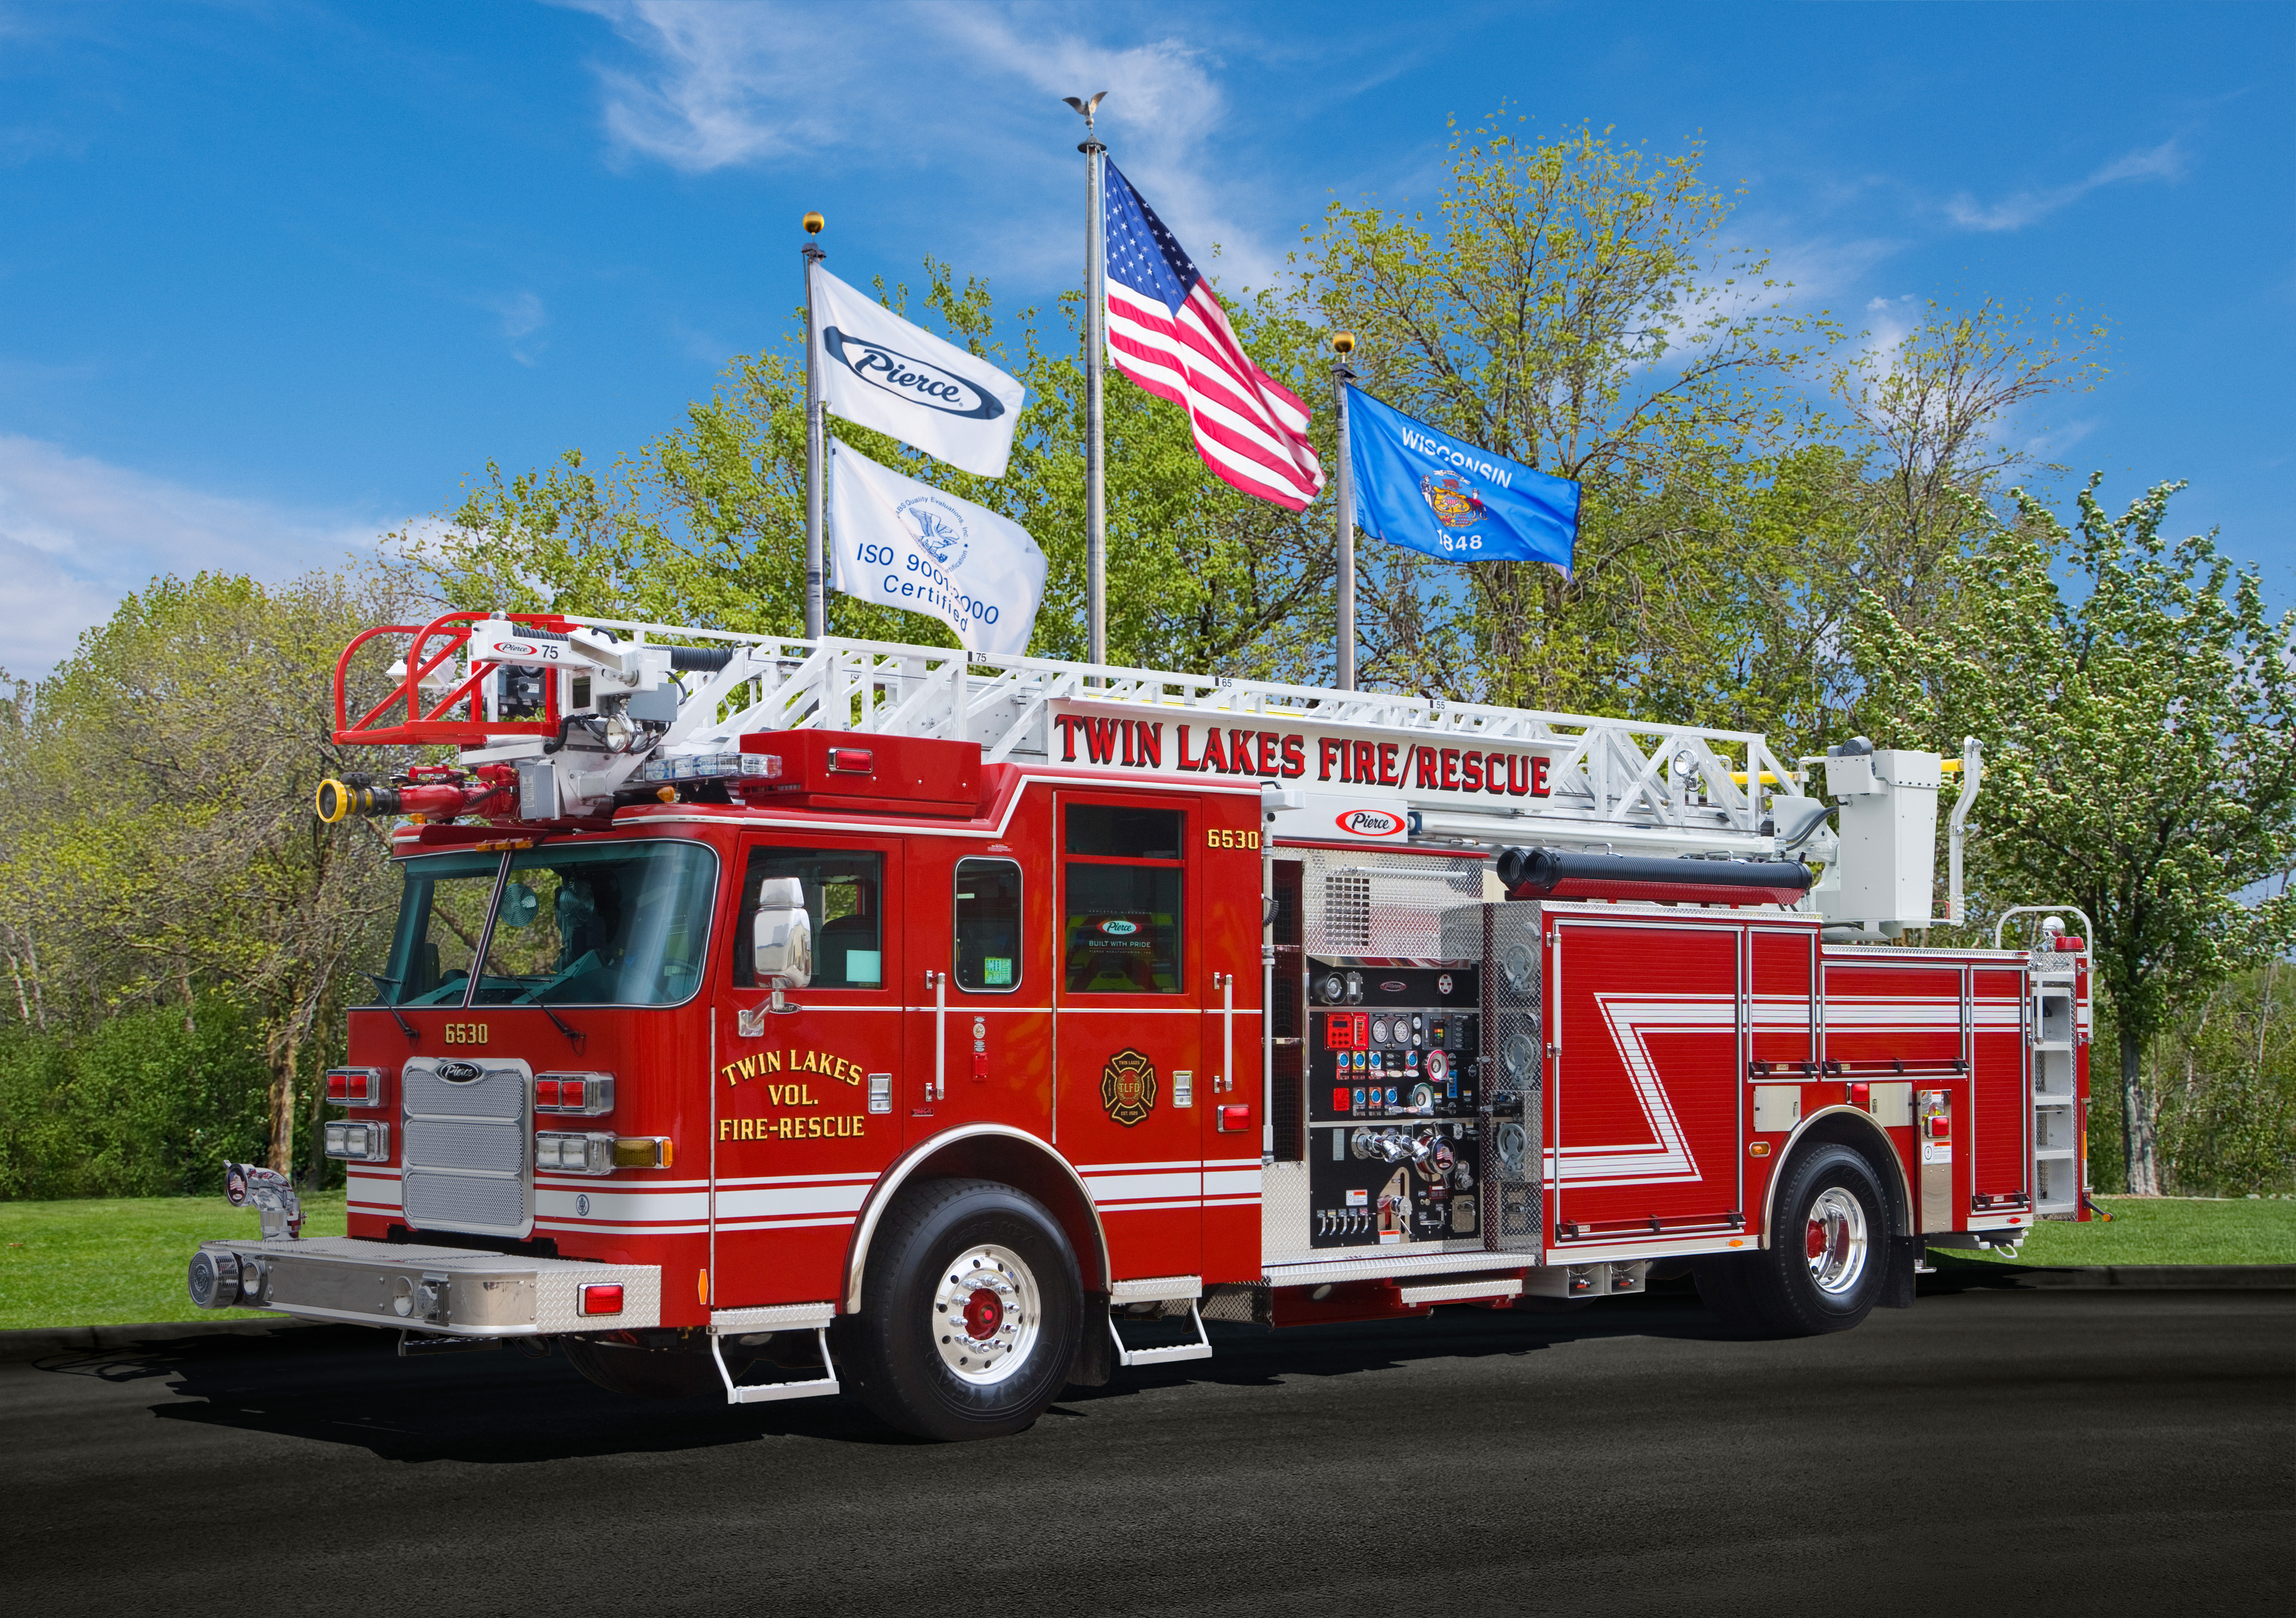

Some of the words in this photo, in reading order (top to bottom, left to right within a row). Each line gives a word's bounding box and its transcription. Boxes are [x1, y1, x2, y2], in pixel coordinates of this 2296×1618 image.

[855, 349, 961, 403] Pierce
[1402, 427, 1513, 489] WISCONSIN
[895, 502, 906, 516] ABS
[905, 496, 928, 506] Quality
[930, 496, 964, 526] Evaluations,
[1437, 529, 1482, 551] 1848
[856, 543, 894, 566] ISO
[906, 553, 999, 625] 9001:2000
[883, 574, 968, 633] Certified
[502, 644, 527, 652] Pierce
[542, 645, 559, 659] 75
[976, 653, 987, 662] 75
[1222, 678, 1232, 688] 65
[1436, 701, 1445, 709] 55
[1054, 713, 1162, 769] TWIN
[1176, 724, 1306, 779] LAKES
[1317, 737, 1551, 798] FIRE/RESCUE
[1352, 813, 1389, 829] Pierce
[1207, 829, 1259, 850] 6530
[1107, 922, 1132, 932] Pierce
[445, 1023, 488, 1044] 6530
[445, 1065, 473, 1079] Pierce
[721, 1050, 782, 1087] TWIN
[789, 1049, 863, 1086] LAKES
[768, 1084, 819, 1106] VOL.
[1119, 1083, 1140, 1092] TLFD
[719, 1115, 865, 1141] FIRE-RESCUE
